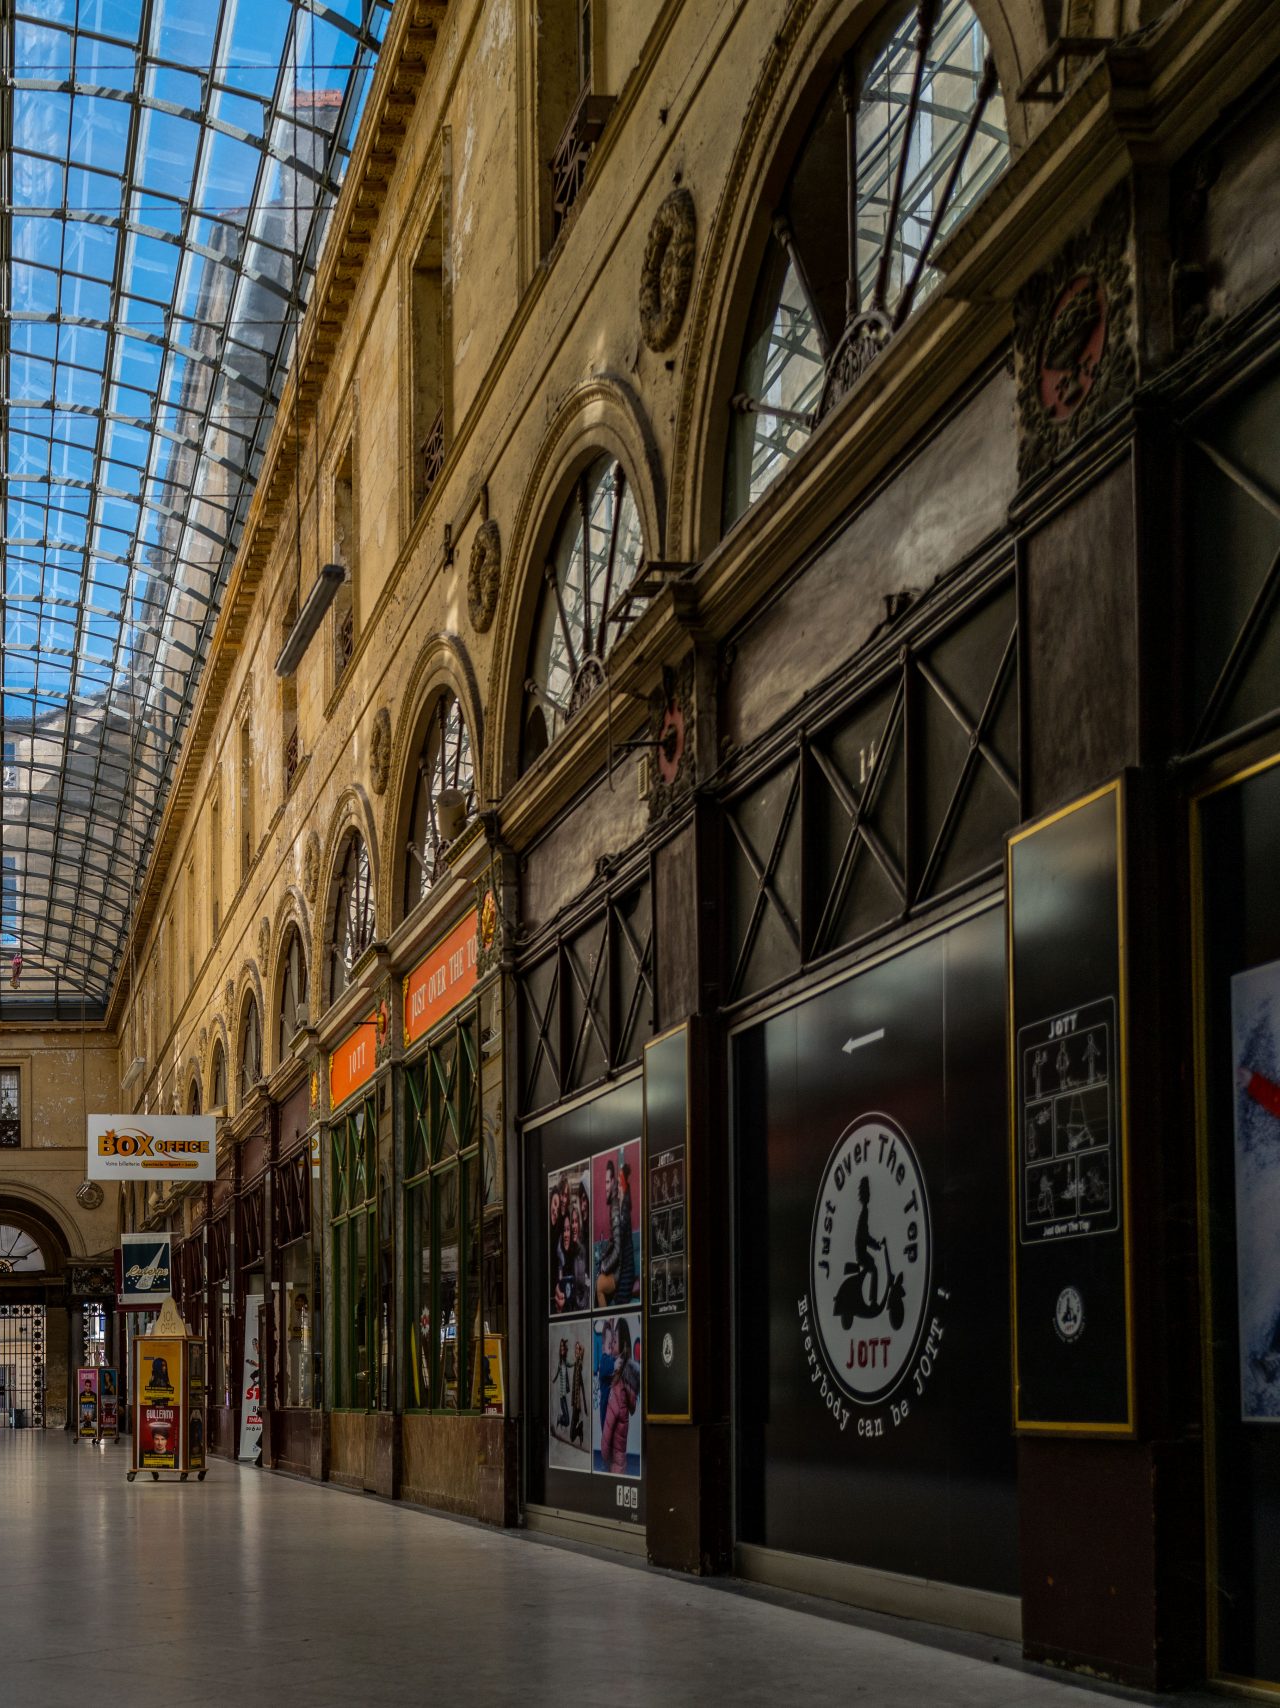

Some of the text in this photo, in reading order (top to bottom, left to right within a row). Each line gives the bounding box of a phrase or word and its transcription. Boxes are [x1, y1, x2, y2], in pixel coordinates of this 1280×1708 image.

[412, 984, 426, 1027] JUST
[429, 964, 447, 1003] OVER
[449, 947, 464, 984] THE
[1048, 1012, 1078, 1039] JOTT
[349, 1041, 365, 1082] JOTT
[98, 1135, 210, 1156] BOX OFFICE
[834, 1138, 871, 1191] Over
[879, 1134, 906, 1186] The
[904, 1190, 919, 1263] Top
[798, 1294, 850, 1431] Everybody
[858, 1416, 883, 1438] can
[890, 1399, 910, 1427] be
[913, 1316, 945, 1396] JOTT
[846, 1337, 891, 1369] JOTT
